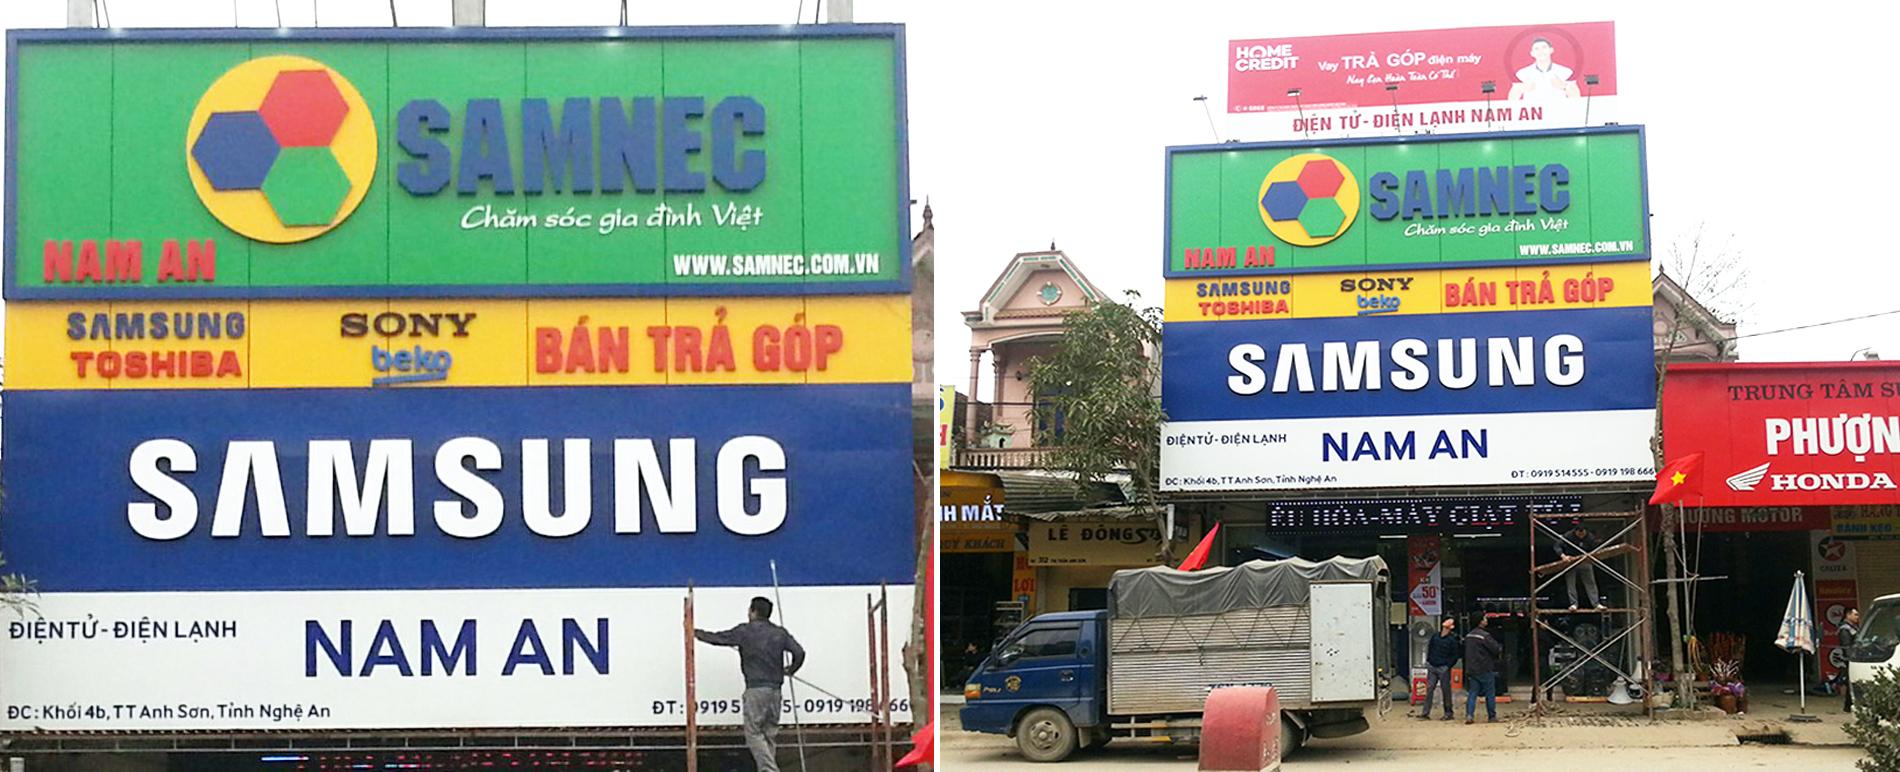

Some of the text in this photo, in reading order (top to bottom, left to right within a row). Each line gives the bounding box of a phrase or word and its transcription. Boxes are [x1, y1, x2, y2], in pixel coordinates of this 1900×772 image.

[1236, 44, 1292, 59] HOME
[1318, 61, 1339, 72] Vay
[1386, 49, 1426, 67] GÓP
[1457, 53, 1481, 65] máy
[1235, 56, 1299, 72] CREDIT
[1420, 110, 1465, 128] LẠNH
[1471, 107, 1512, 124] NAM
[1518, 107, 1543, 121] AN
[398, 95, 767, 197] SAMNEC
[1369, 163, 1570, 221] SAMNEC
[461, 201, 764, 234] Chăm sóc gia đình Việt
[1404, 217, 1569, 237] Chăm sóc gia đình Việt
[1184, 245, 1275, 270] NAM AN
[1519, 240, 1634, 256] WWW.SAMNEC.COM.VN
[43, 238, 217, 284] NAM AN
[673, 253, 880, 276] WWW.SAMNEC.COM.VN
[1196, 280, 1291, 298] SAMSUNG
[1340, 277, 1414, 293] SONY
[1444, 271, 1615, 308] BÁN TRẢ GÓP
[1199, 299, 1289, 316] TOSHIBA
[1357, 293, 1400, 310] beko
[66, 311, 246, 342] SAMSUNG
[339, 312, 477, 340] SONY
[534, 307, 845, 375] BÁN TRẢ GÓP
[72, 349, 243, 380] TOSHIBA
[371, 343, 453, 377] beko
[1227, 334, 1587, 395] SAMSUNG
[1728, 384, 1814, 400] TRUNG
[1820, 379, 1873, 398] TÂM
[1221, 432, 1250, 447] ĐIỆN
[1253, 433, 1287, 446] LẠNH
[1321, 428, 1489, 462] NAM AN
[1765, 413, 1900, 462] PHƯỢN
[126, 434, 789, 542] SAMSUNG
[1324, 475, 1337, 483] An
[1771, 473, 1897, 490] HONDA
[961, 495, 1004, 521] MẮT
[1048, 524, 1069, 541] LÊ
[113, 616, 168, 643] ĐIỆN
[175, 620, 237, 643] LẠNH
[304, 617, 611, 678] NAM AN
[43, 702, 82, 720] Khối
[139, 704, 174, 719] Anh
[216, 701, 254, 719] Tỉnh
[259, 703, 303, 722] Nghệ
[308, 703, 331, 718] An
[804, 699, 843, 713] 0919
